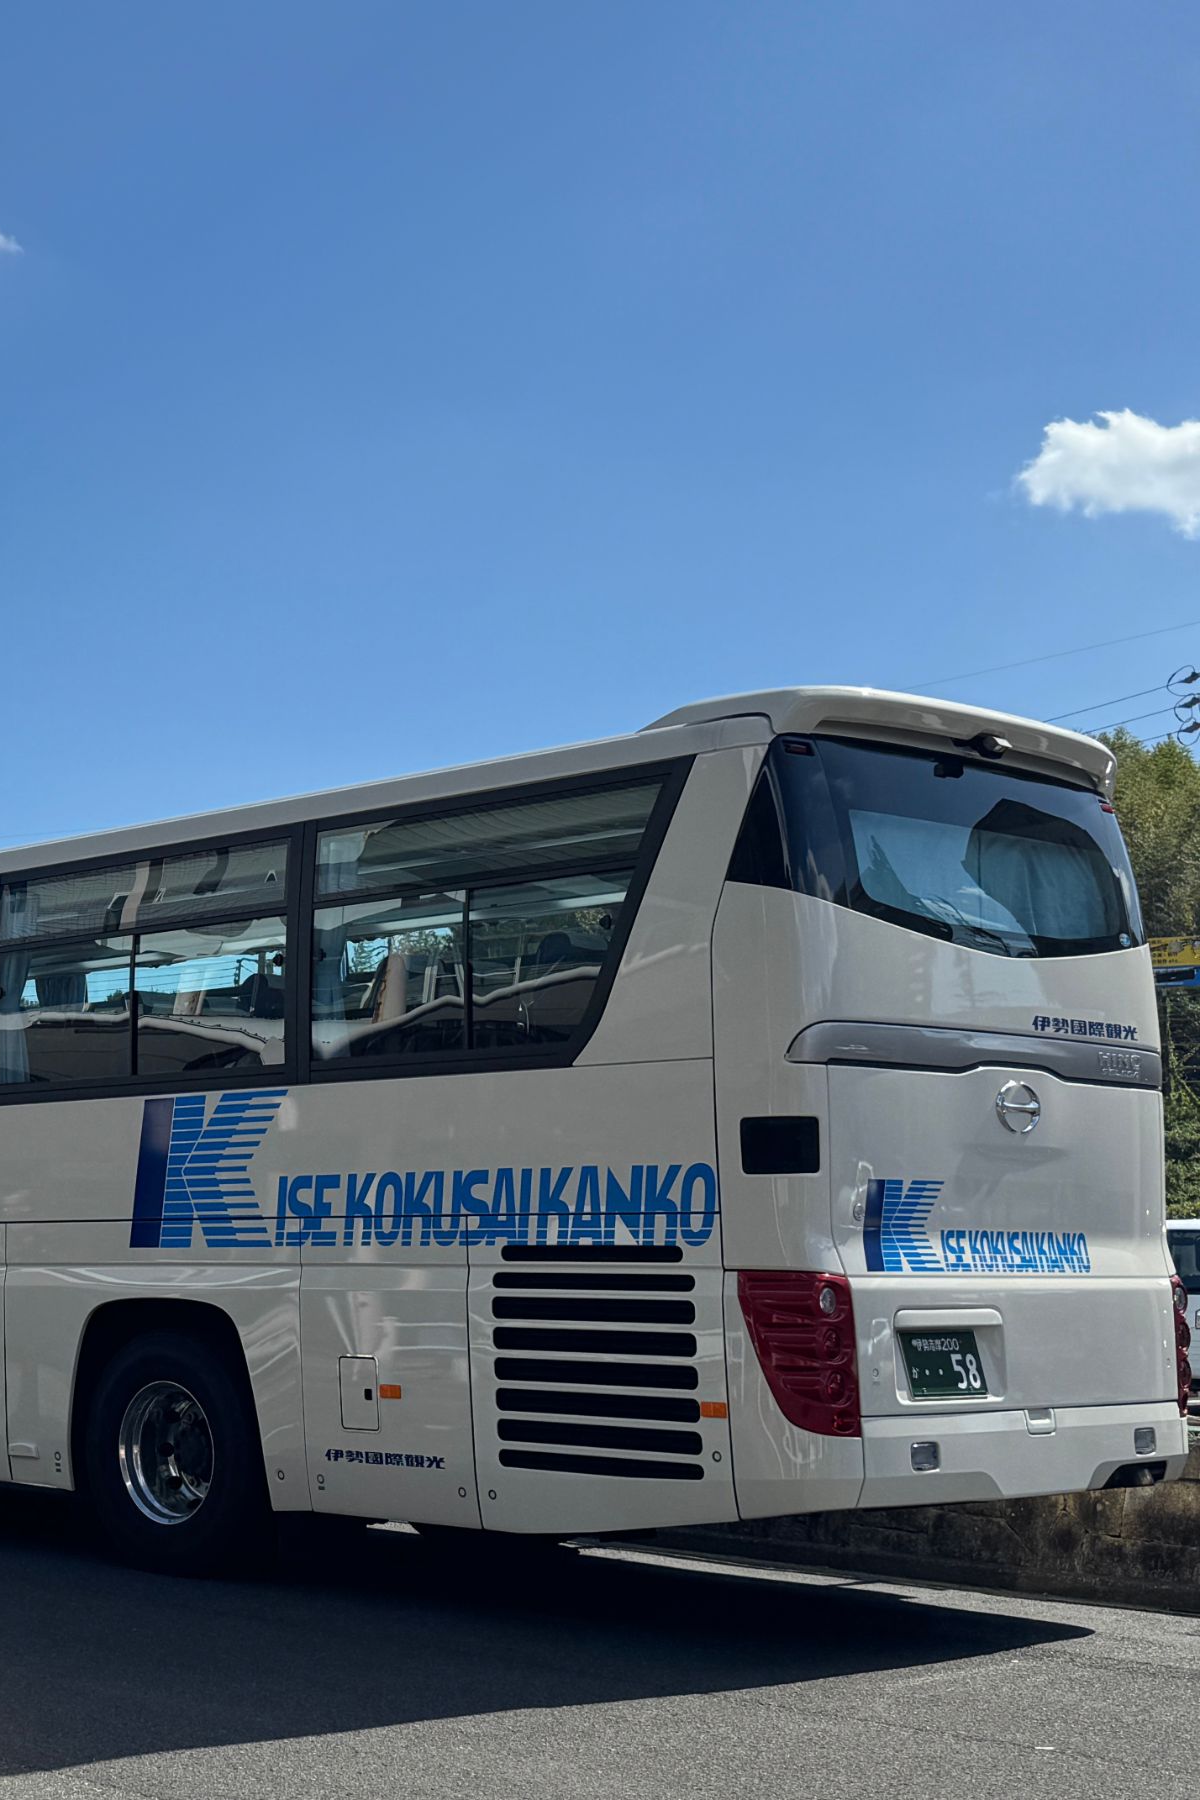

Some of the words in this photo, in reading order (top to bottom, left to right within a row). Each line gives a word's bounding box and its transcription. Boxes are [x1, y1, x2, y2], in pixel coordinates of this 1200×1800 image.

[1031, 1015, 1138, 1041] 伊勢國際観光
[325, 1448, 446, 1469] 伊勢國際観光
